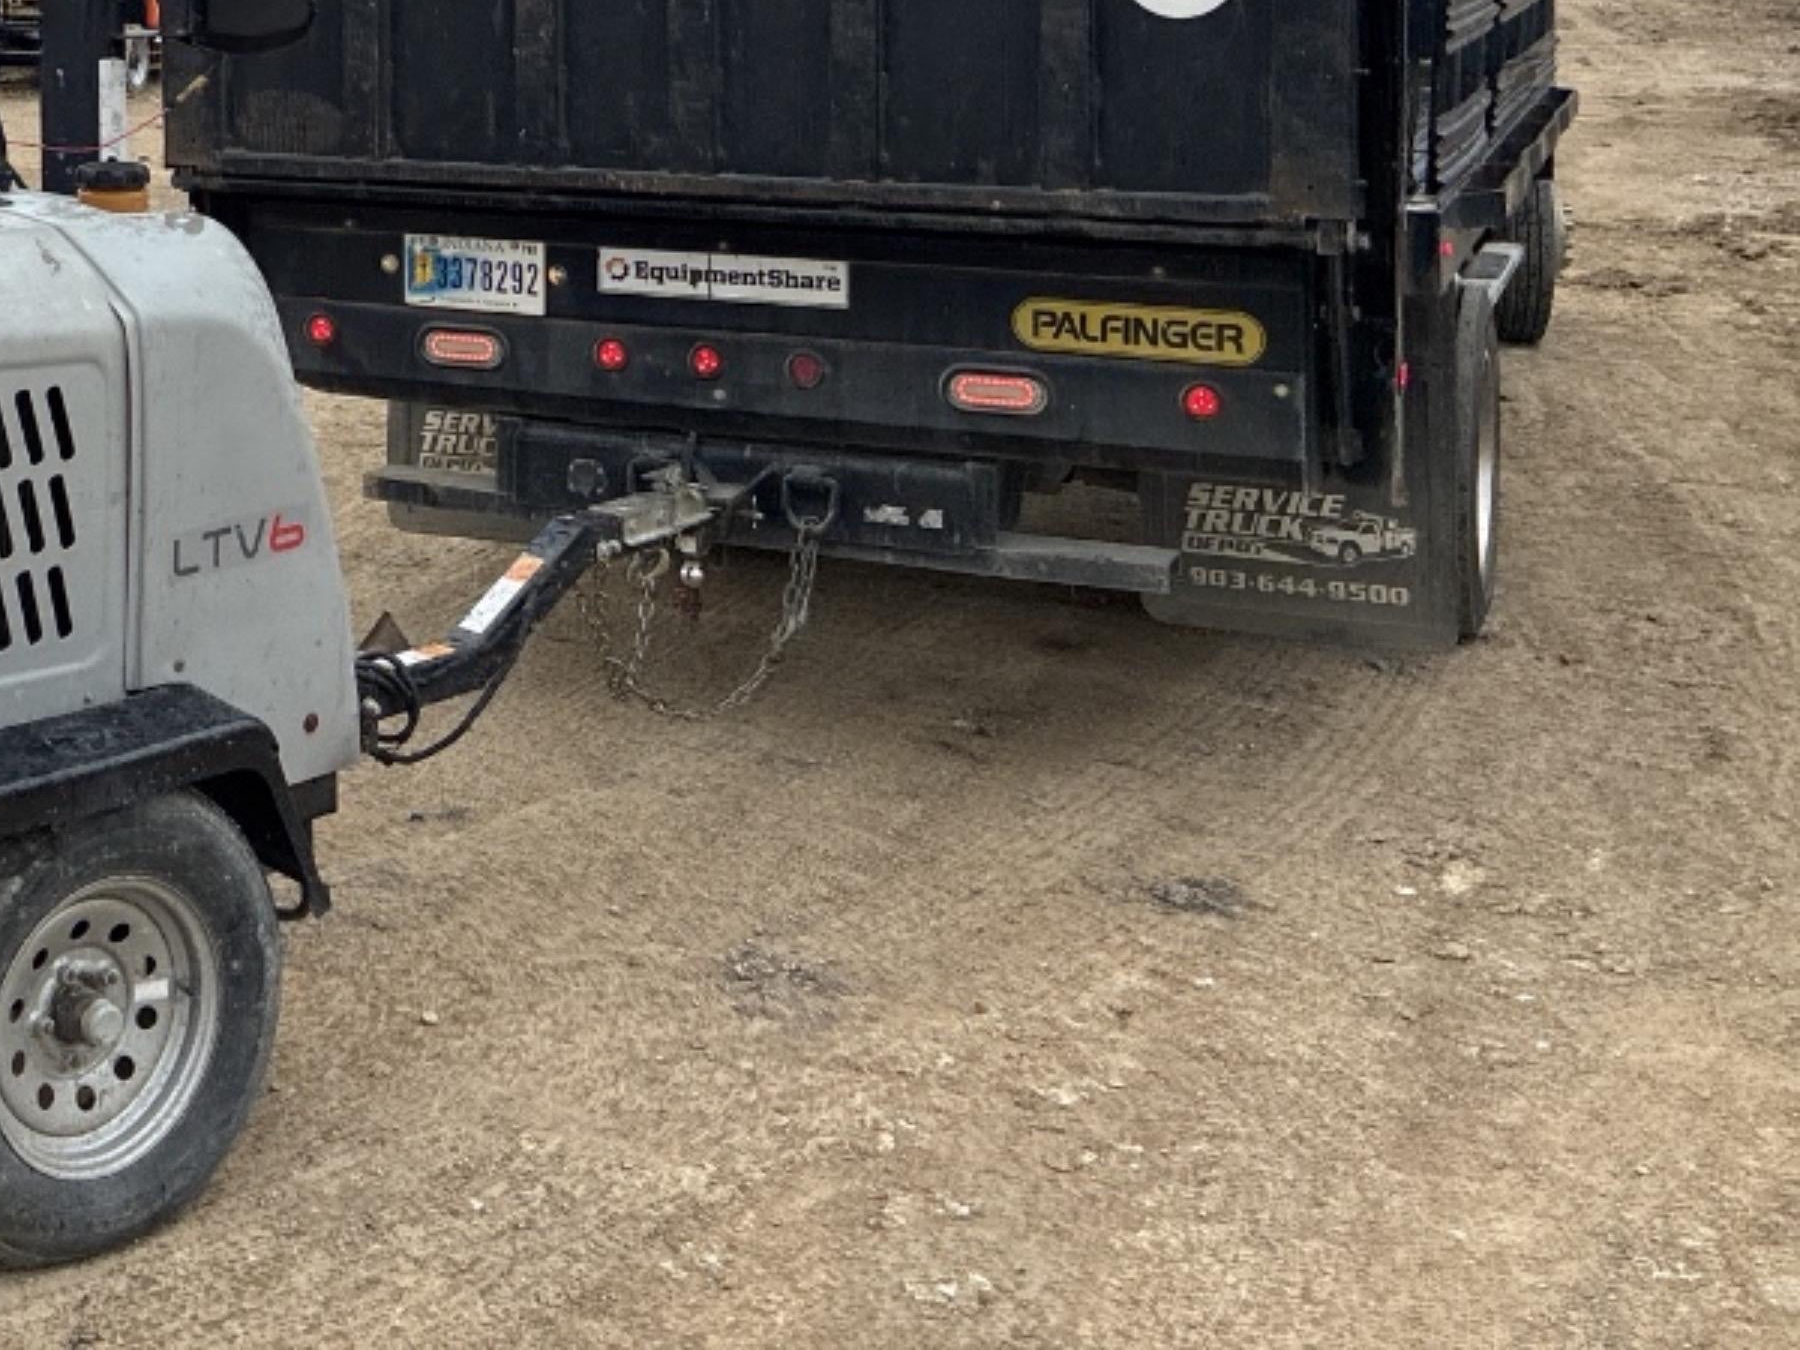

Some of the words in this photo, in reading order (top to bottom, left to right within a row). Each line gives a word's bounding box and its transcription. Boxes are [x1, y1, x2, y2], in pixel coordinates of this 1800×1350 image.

[437, 256, 538, 298] 3378292
[635, 260, 842, 293] EquipmentShare
[1032, 308, 1244, 355] PALFINGER
[1187, 482, 1346, 519] SERVICE
[1185, 506, 1304, 541] TRUCK
[173, 512, 305, 577] LTV6
